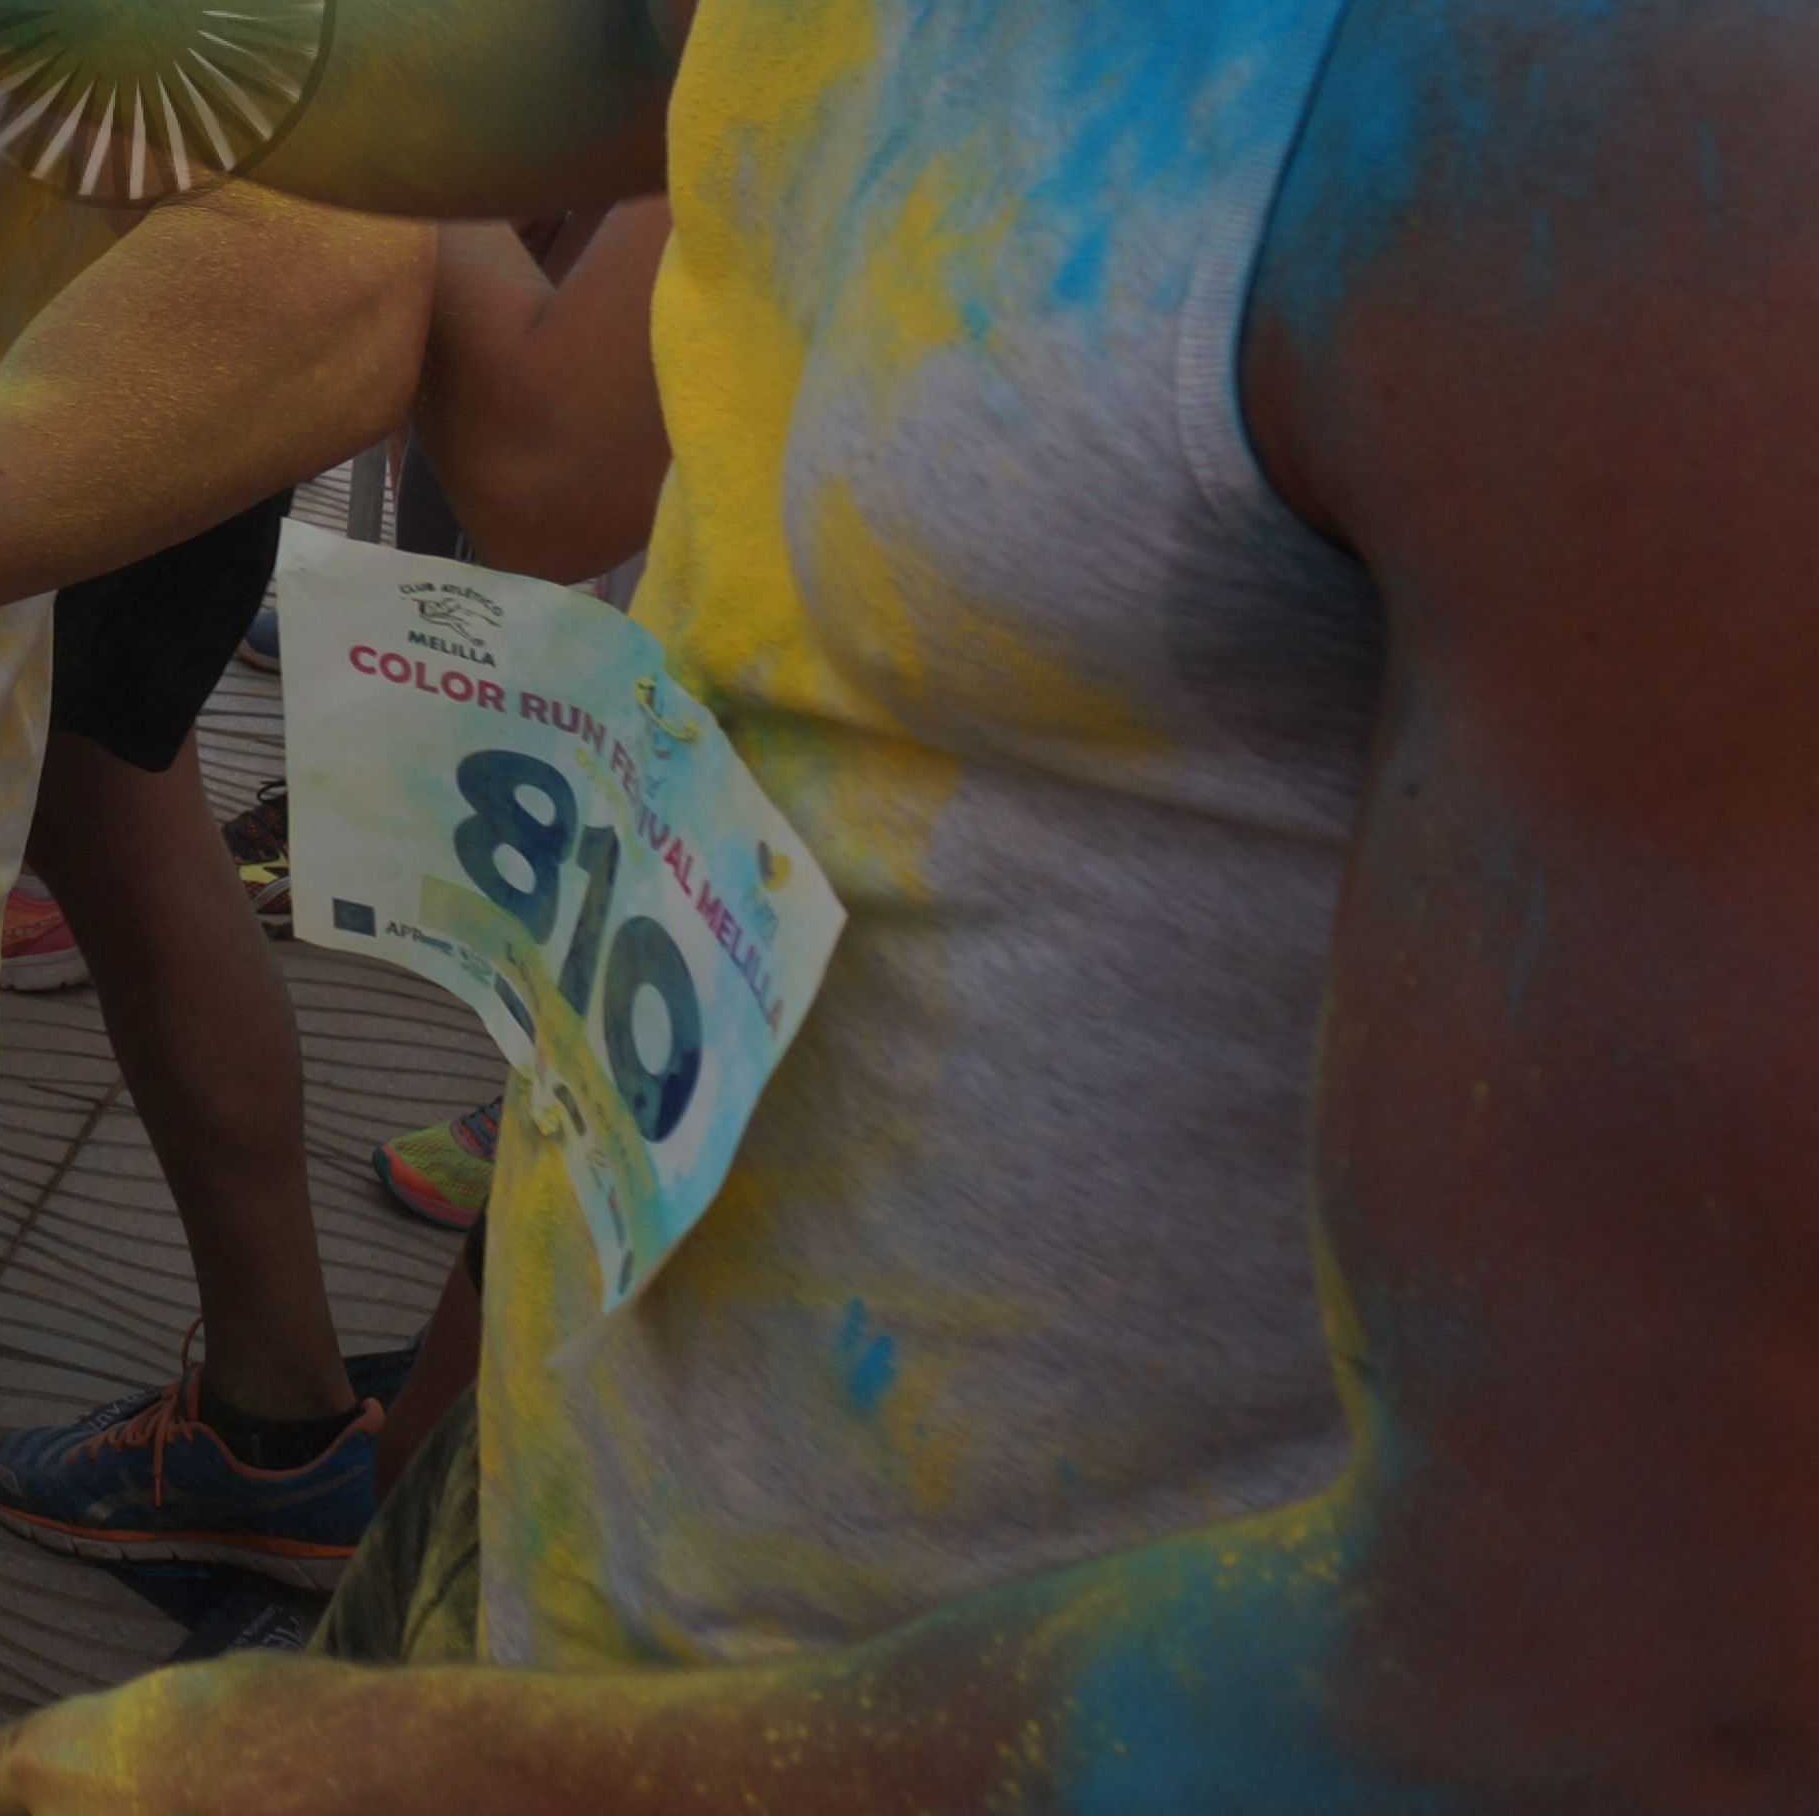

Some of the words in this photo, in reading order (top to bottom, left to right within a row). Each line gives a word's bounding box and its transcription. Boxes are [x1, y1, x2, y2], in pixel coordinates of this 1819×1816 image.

[349, 645, 507, 712] COLOR
[519, 691, 607, 754] RUN
[408, 630, 497, 669] MELILLA
[453, 749, 704, 1144] 810
